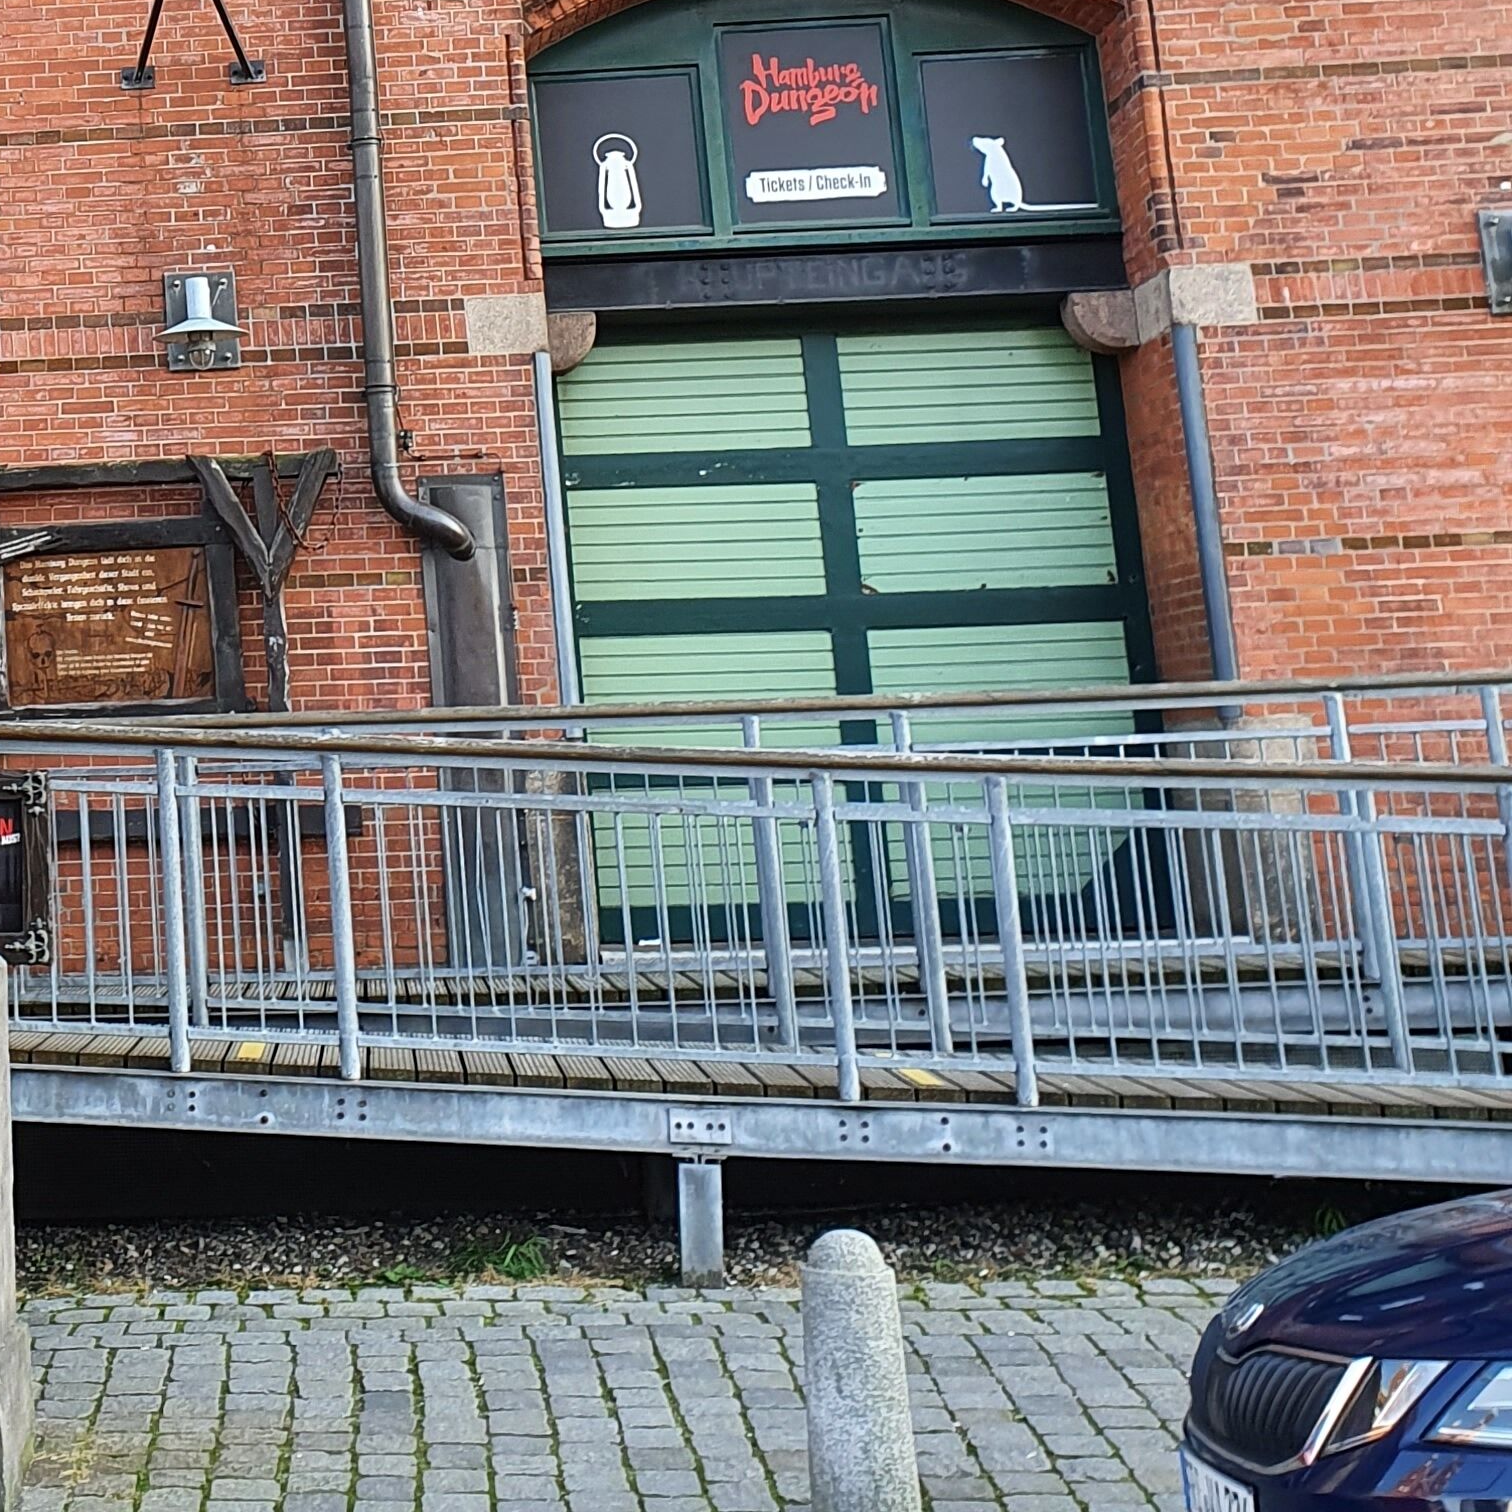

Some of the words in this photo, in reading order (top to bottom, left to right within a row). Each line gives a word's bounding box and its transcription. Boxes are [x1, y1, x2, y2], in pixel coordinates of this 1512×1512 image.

[752, 53, 864, 88] Hamburg
[740, 80, 877, 125] Dungeon
[759, 177, 805, 193] Tickets
[815, 173, 872, 190] Check-In
